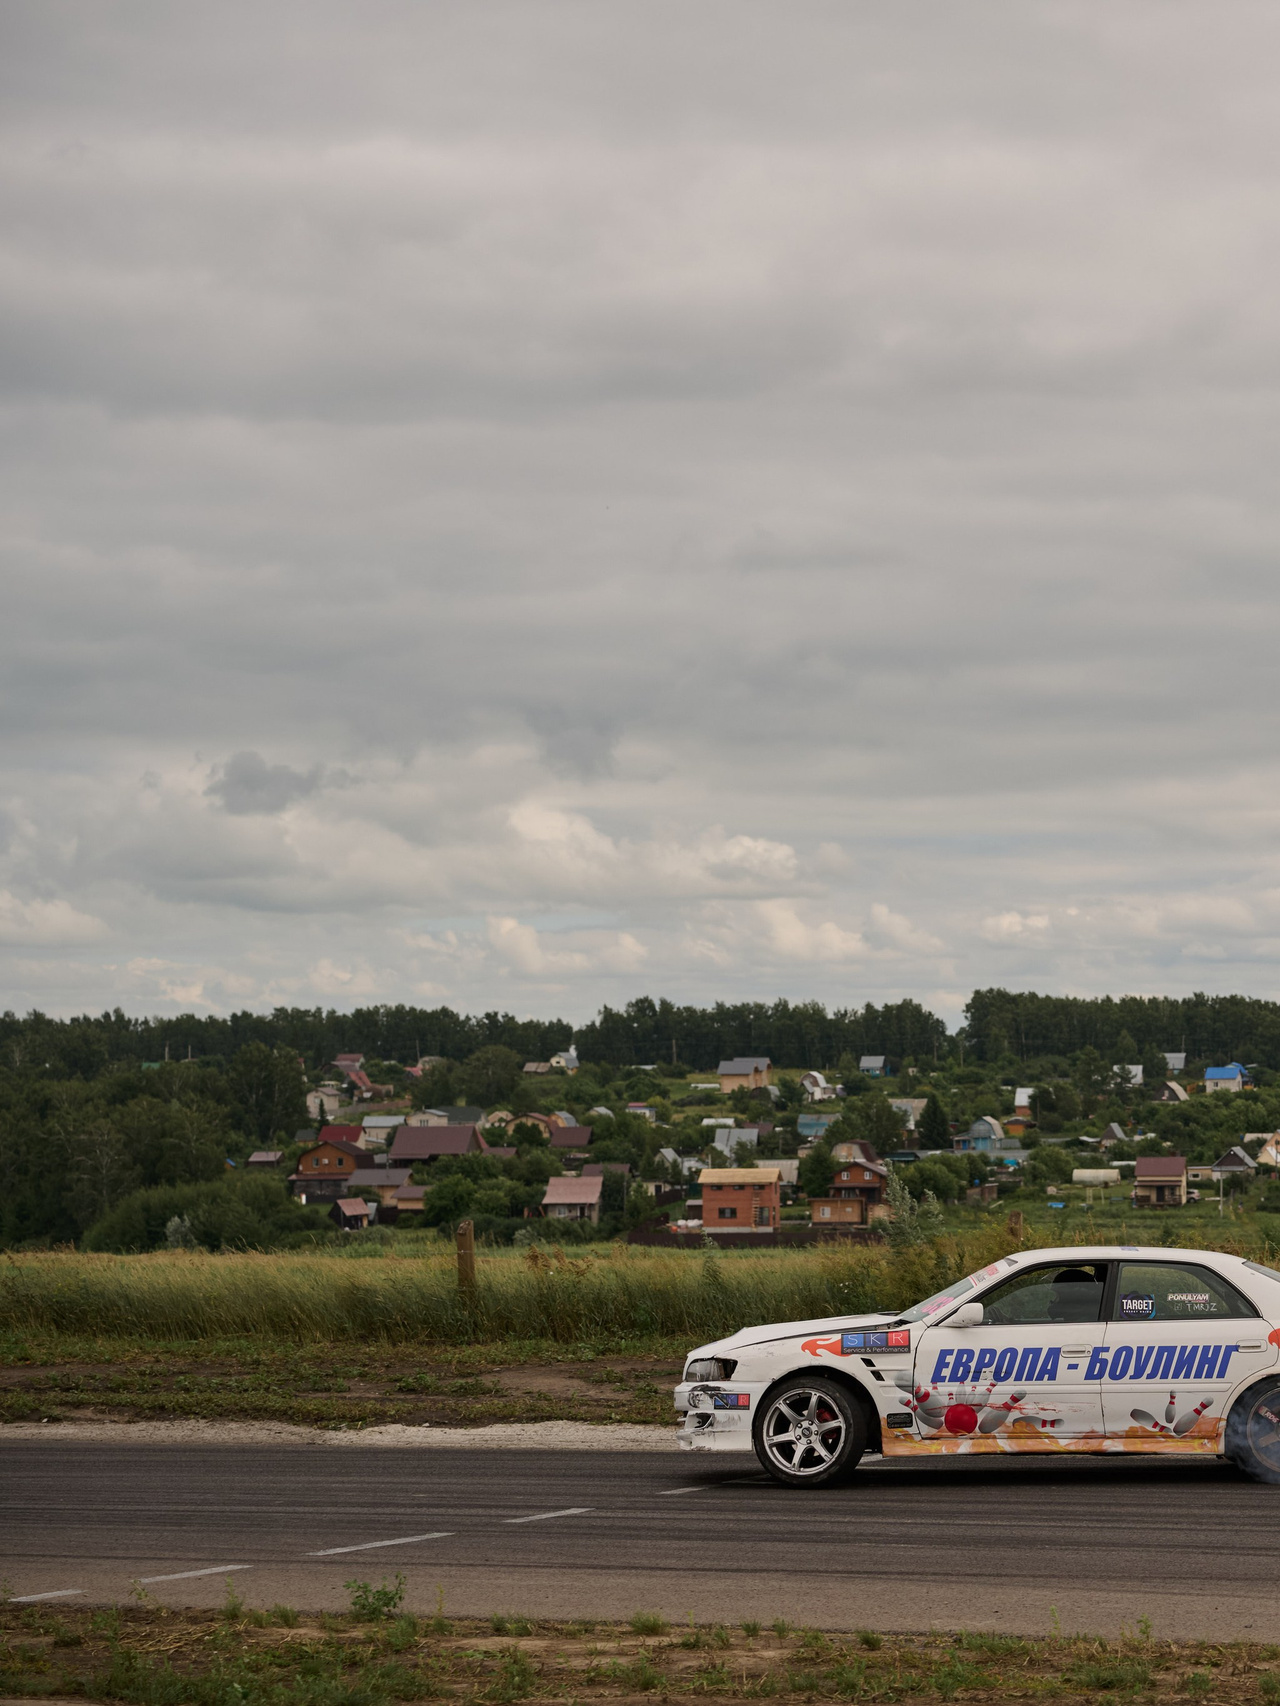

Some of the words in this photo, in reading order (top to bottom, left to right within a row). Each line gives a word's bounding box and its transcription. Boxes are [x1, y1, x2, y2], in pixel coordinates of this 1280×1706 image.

[1121, 1299, 1154, 1310] TARGET
[847, 1332, 904, 1346] SKR
[930, 1346, 1062, 1383] ЕВРОПА
[1083, 1344, 1240, 1381] БОУЛИНГ
